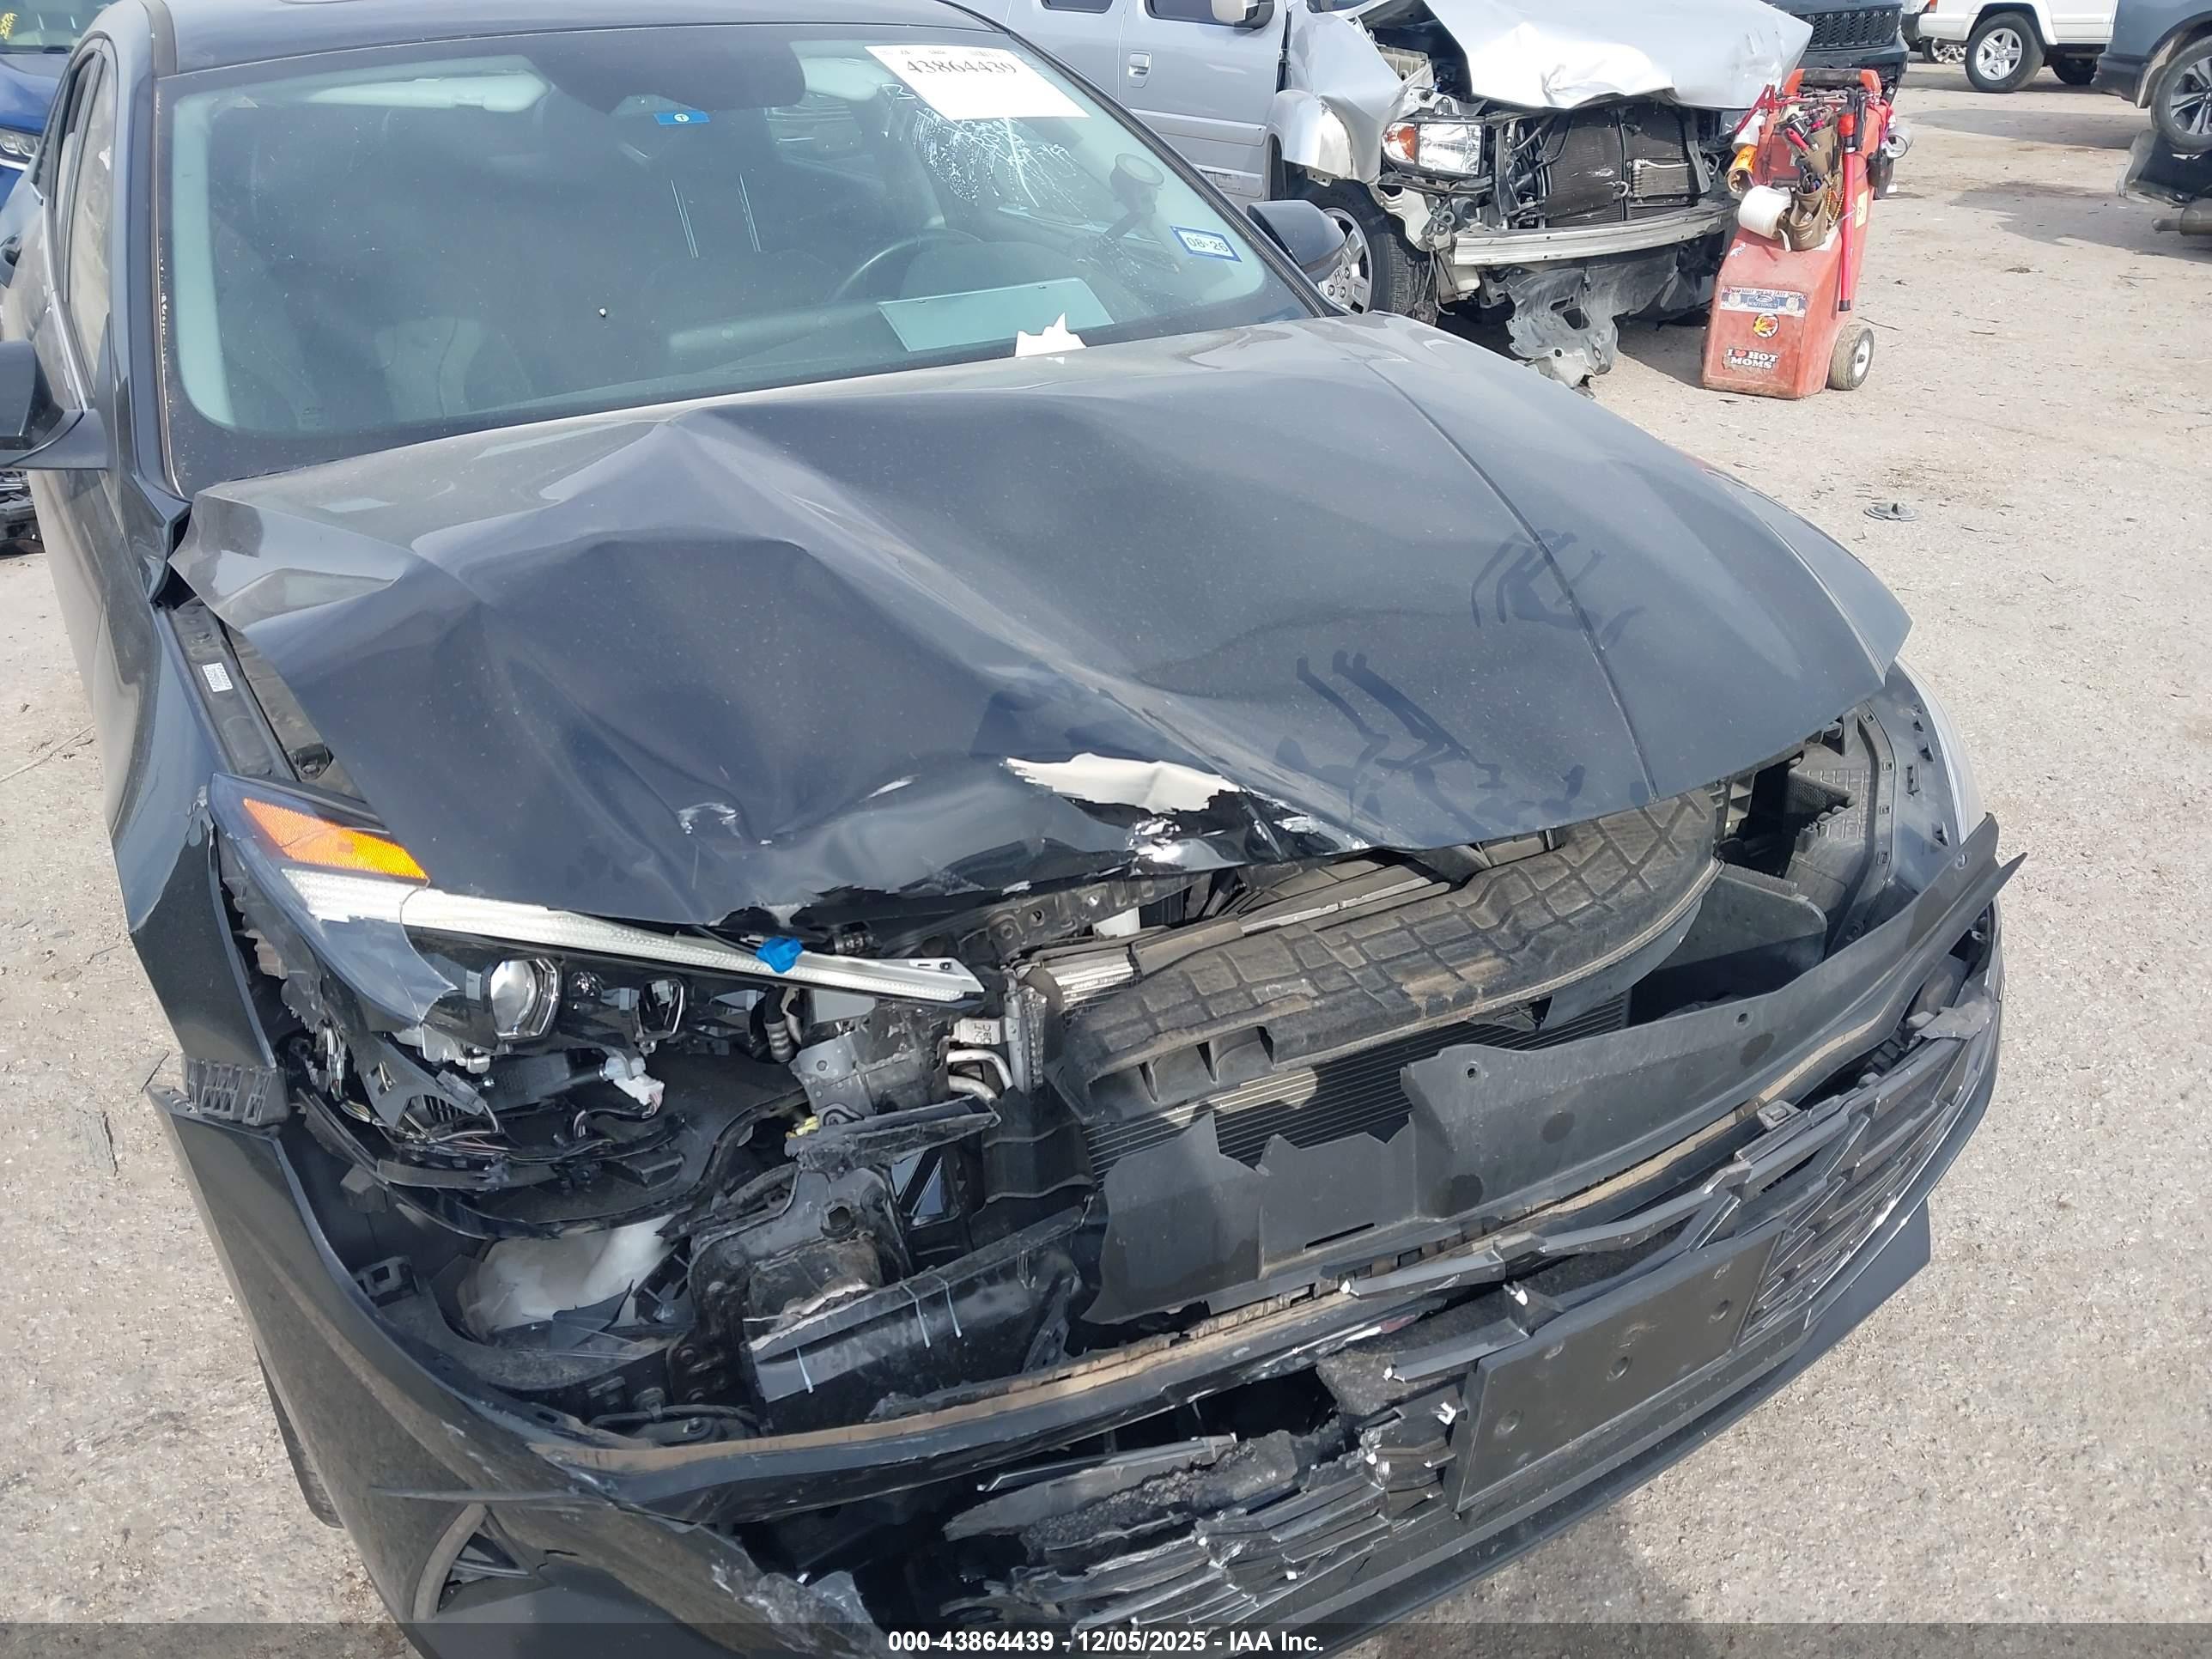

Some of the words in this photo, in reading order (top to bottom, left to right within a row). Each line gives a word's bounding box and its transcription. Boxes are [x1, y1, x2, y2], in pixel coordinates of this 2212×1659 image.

[907, 60, 1018, 74] 43864439
[1730, 356, 1773, 369] MOMS
[1748, 351, 1779, 362] HOT
